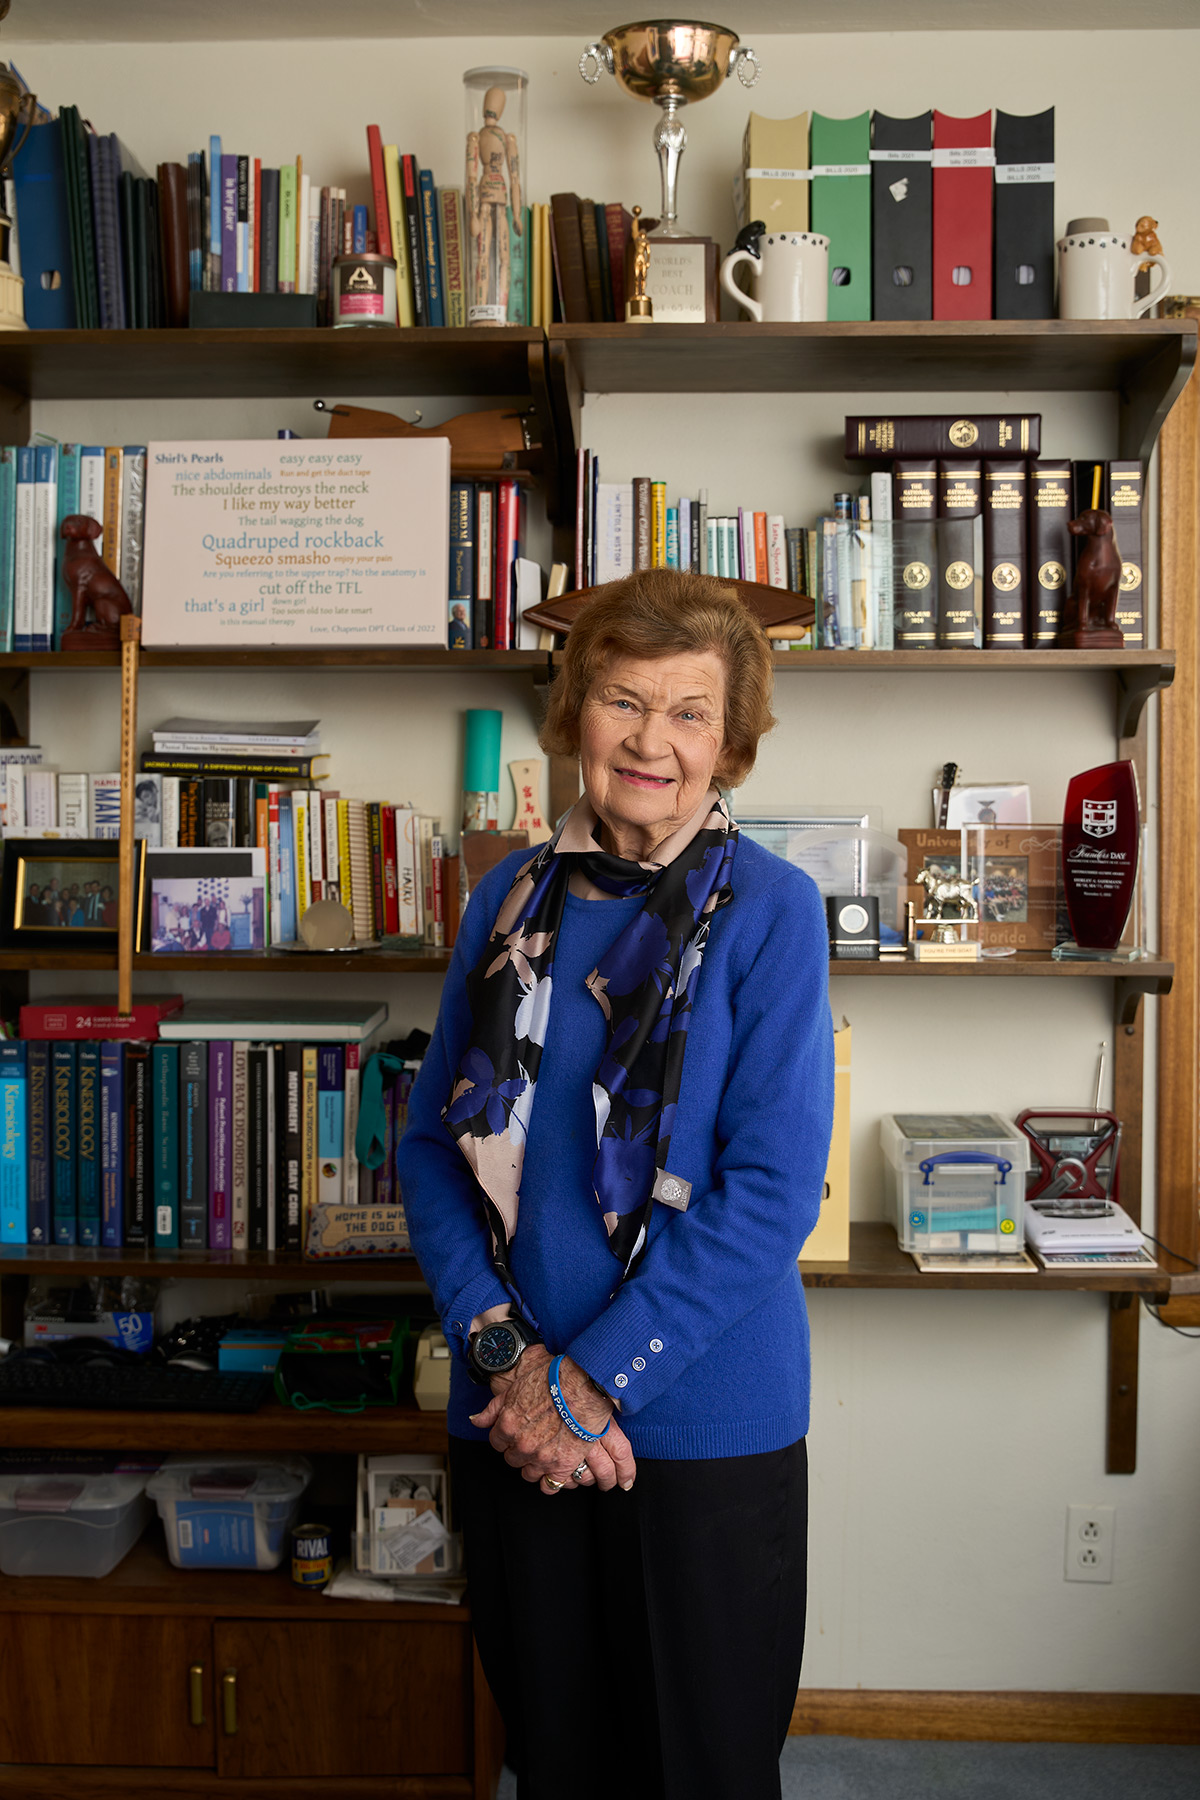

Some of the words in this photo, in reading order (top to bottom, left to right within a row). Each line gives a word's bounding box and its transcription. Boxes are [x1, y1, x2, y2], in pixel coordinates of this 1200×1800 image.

[225, 178, 234, 187] in
[225, 189, 234, 204] her
[444, 192, 457, 222] UNDER
[223, 206, 234, 232] place
[445, 224, 458, 241] THE
[446, 242, 460, 290] INFLUENCE
[662, 270, 683, 278] BEST
[652, 285, 693, 295] COACH
[154, 453, 188, 465] Shirl's
[191, 453, 224, 463] Pearls
[279, 454, 306, 466] easy
[308, 454, 334, 465] easy
[336, 454, 363, 465] easy
[175, 470, 200, 481] nice
[203, 468, 272, 481] abdominals
[311, 470, 323, 479] get
[324, 469, 336, 477] the
[355, 470, 371, 478] tape
[172, 484, 196, 496] The
[199, 483, 255, 496] shoulder
[258, 483, 312, 497] destroys
[314, 483, 336, 494] the
[339, 482, 369, 494] neck
[223, 499, 229, 510] I
[232, 498, 256, 510] like
[259, 500, 280, 513] my
[283, 499, 311, 513] way
[314, 497, 356, 510] better
[638, 482, 648, 516] William
[450, 490, 458, 538] KENNEDY
[459, 490, 468, 528] EDWARD
[238, 516, 257, 526] The
[259, 516, 277, 526] tail
[279, 517, 323, 528] wagging
[325, 515, 342, 526] the
[344, 516, 364, 527] dog
[202, 534, 299, 553] Quadruped
[304, 531, 384, 549] rockback
[215, 553, 274, 569] Squeezo
[277, 551, 331, 565] smasho
[334, 556, 351, 564] enjoy
[375, 555, 392, 563] pain
[203, 570, 217, 578] Are
[218, 571, 234, 580] you
[236, 569, 273, 579] referring
[285, 569, 299, 577] the
[301, 570, 323, 579] upper
[325, 569, 349, 579] trap?
[351, 568, 364, 576] No
[364, 568, 378, 576] the
[380, 569, 417, 579] anatomy
[418, 568, 426, 576] is
[259, 583, 282, 595] cut
[285, 581, 307, 594] off
[309, 582, 332, 594] the
[335, 581, 362, 594] TFL
[185, 599, 226, 613] that's
[228, 602, 237, 612] a
[240, 599, 265, 614] girl
[293, 597, 306, 606] girl
[272, 607, 285, 615] Too
[268, 618, 295, 627] therapy
[310, 625, 329, 634] Love,
[331, 625, 367, 634] Chapman
[407, 624, 415, 632] of
[95, 789, 121, 823] MAN
[996, 834, 1010, 848] of
[1069, 843, 1109, 862] Founders
[1110, 852, 1126, 860] DAY
[76, 1017, 91, 1028] 24
[236, 1050, 246, 1080] LOW
[236, 1083, 246, 1115] BACK
[288, 1071, 298, 1134] MOVEMENT
[31, 1066, 46, 1157] KINESIOLOGY
[56, 1066, 71, 1160] KINESIOLOGY
[80, 1066, 96, 1160] KINESIOLOGY
[2, 1085, 20, 1160] Kinesiology
[235, 1118, 245, 1187] DISORDERS
[288, 1160, 298, 1191] GRAY
[288, 1194, 298, 1225] COOK
[335, 1211, 368, 1221] HOME
[372, 1211, 382, 1219] IS
[345, 1222, 366, 1232] THE
[371, 1222, 394, 1231] DOG
[118, 1314, 142, 1335] 50
[296, 1538, 328, 1558] RIVAL
